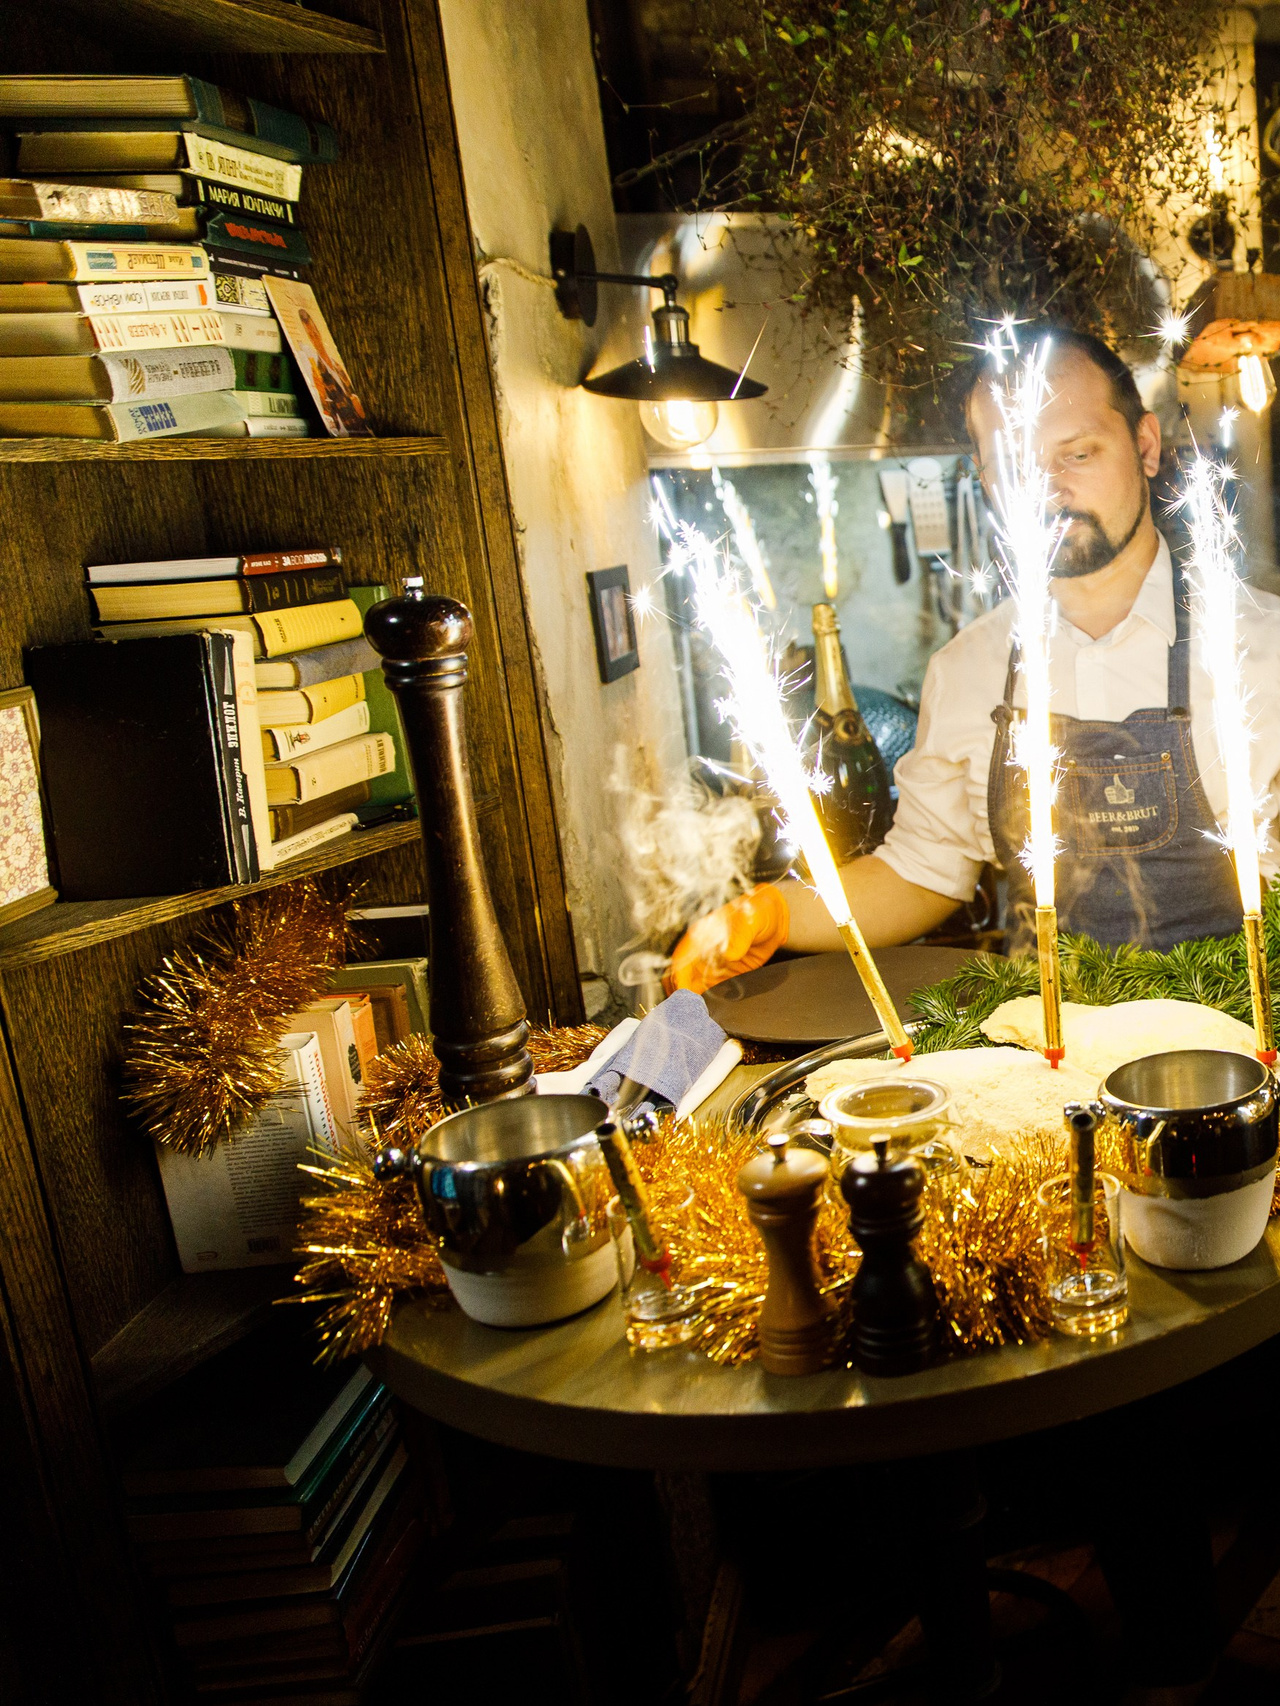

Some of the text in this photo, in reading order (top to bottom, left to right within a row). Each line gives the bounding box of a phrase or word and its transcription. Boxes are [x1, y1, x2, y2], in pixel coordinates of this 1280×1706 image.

[208, 185, 240, 208] МАРИЯ
[222, 701, 247, 819] В. Каверин ЭПИЛОГ
[1088, 805, 1159, 823] BEER&BRUT
